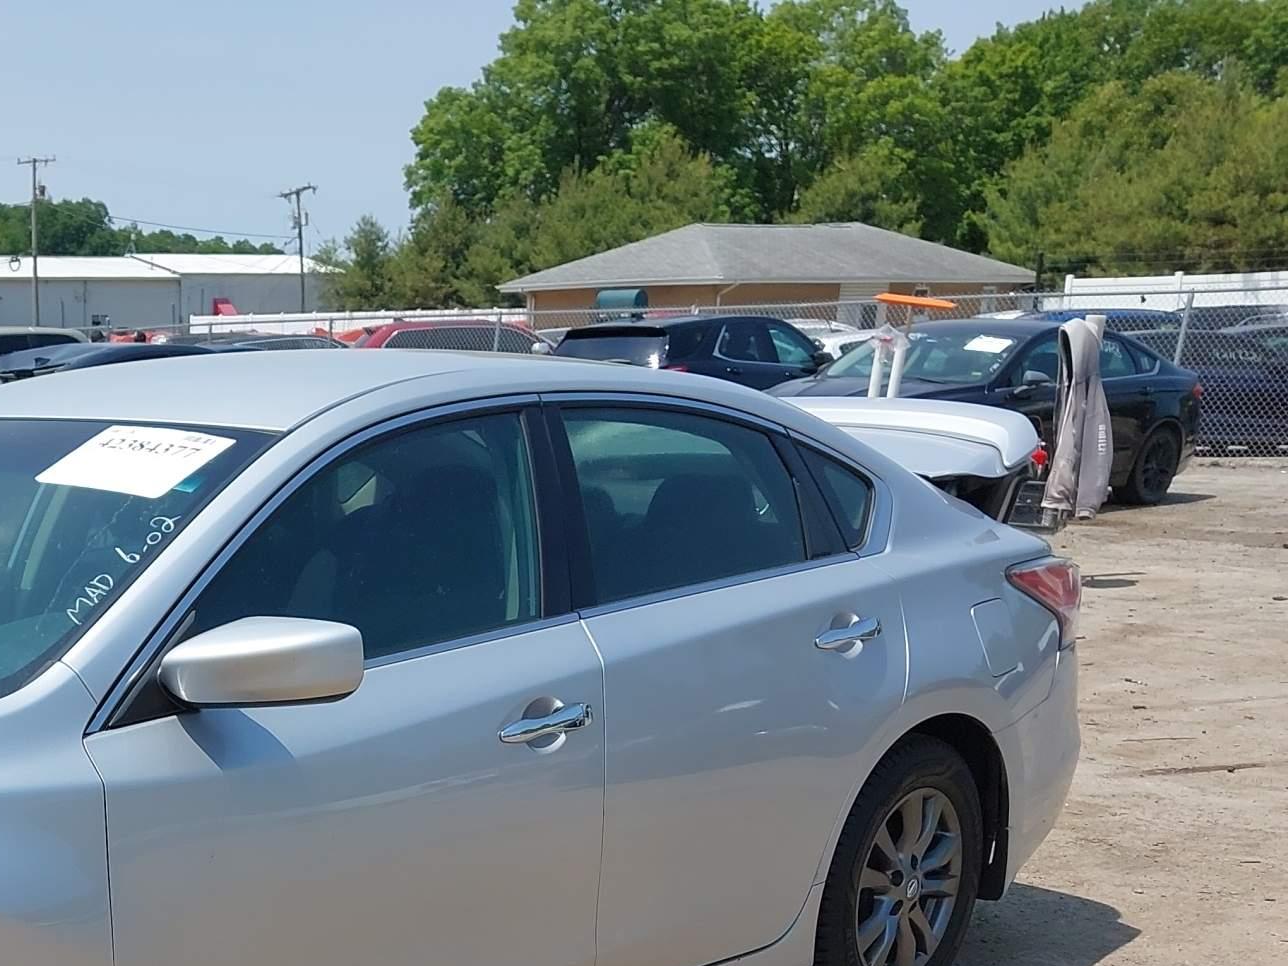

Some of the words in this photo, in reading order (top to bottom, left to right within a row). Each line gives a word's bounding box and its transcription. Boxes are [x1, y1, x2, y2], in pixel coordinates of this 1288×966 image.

[98, 437, 202, 458] 42384377
[66, 573, 114, 625] MAD
[114, 514, 182, 564] 6-02
